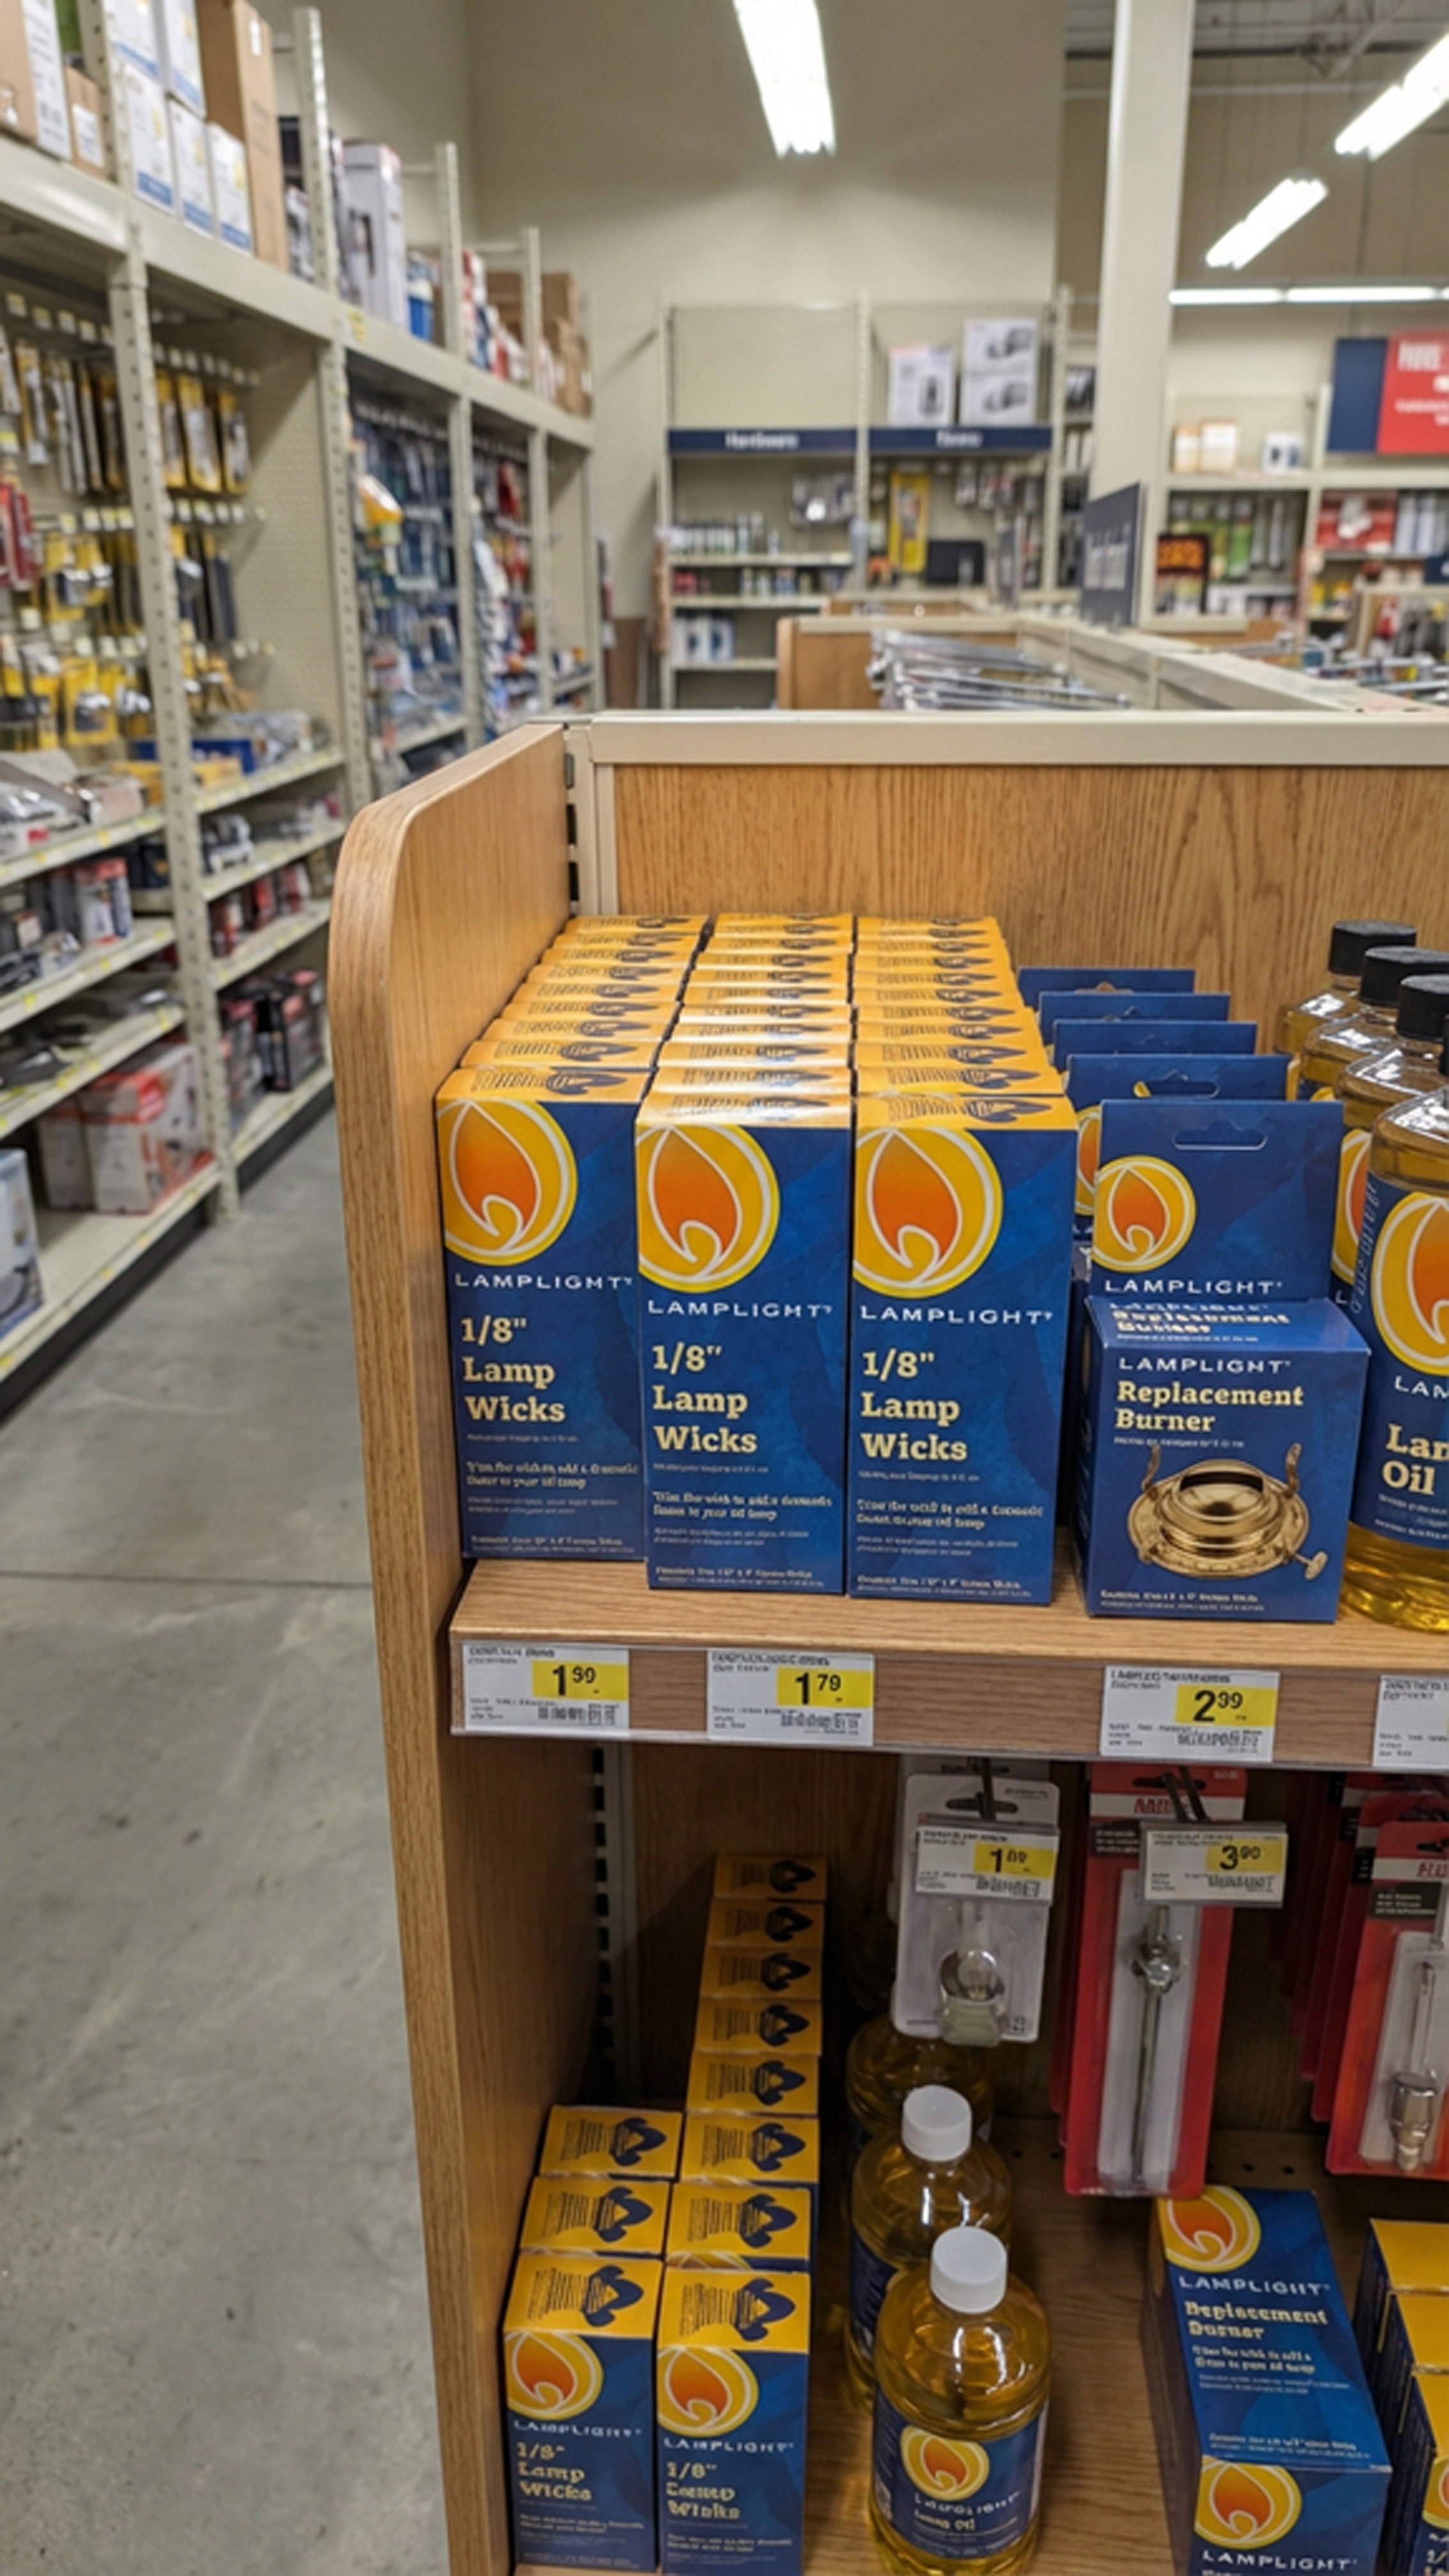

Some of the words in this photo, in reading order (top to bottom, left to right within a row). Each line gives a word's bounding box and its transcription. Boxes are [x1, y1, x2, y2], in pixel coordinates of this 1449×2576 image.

[461, 1314, 527, 1346] 1/8"
[462, 1356, 555, 1390] Lamp
[652, 1342, 723, 1374] 1/8"
[862, 1348, 935, 1381] 1/8"
[464, 1395, 565, 1422] Wicks
[652, 1385, 748, 1419] Lamp
[861, 1392, 960, 1427] Lamp
[1117, 1380, 1304, 1407] Replacement
[1114, 1408, 1216, 1432] Burner
[653, 1425, 758, 1453] Wicks
[861, 1432, 967, 1460] Wicks
[1382, 1459, 1435, 1496] Oil
